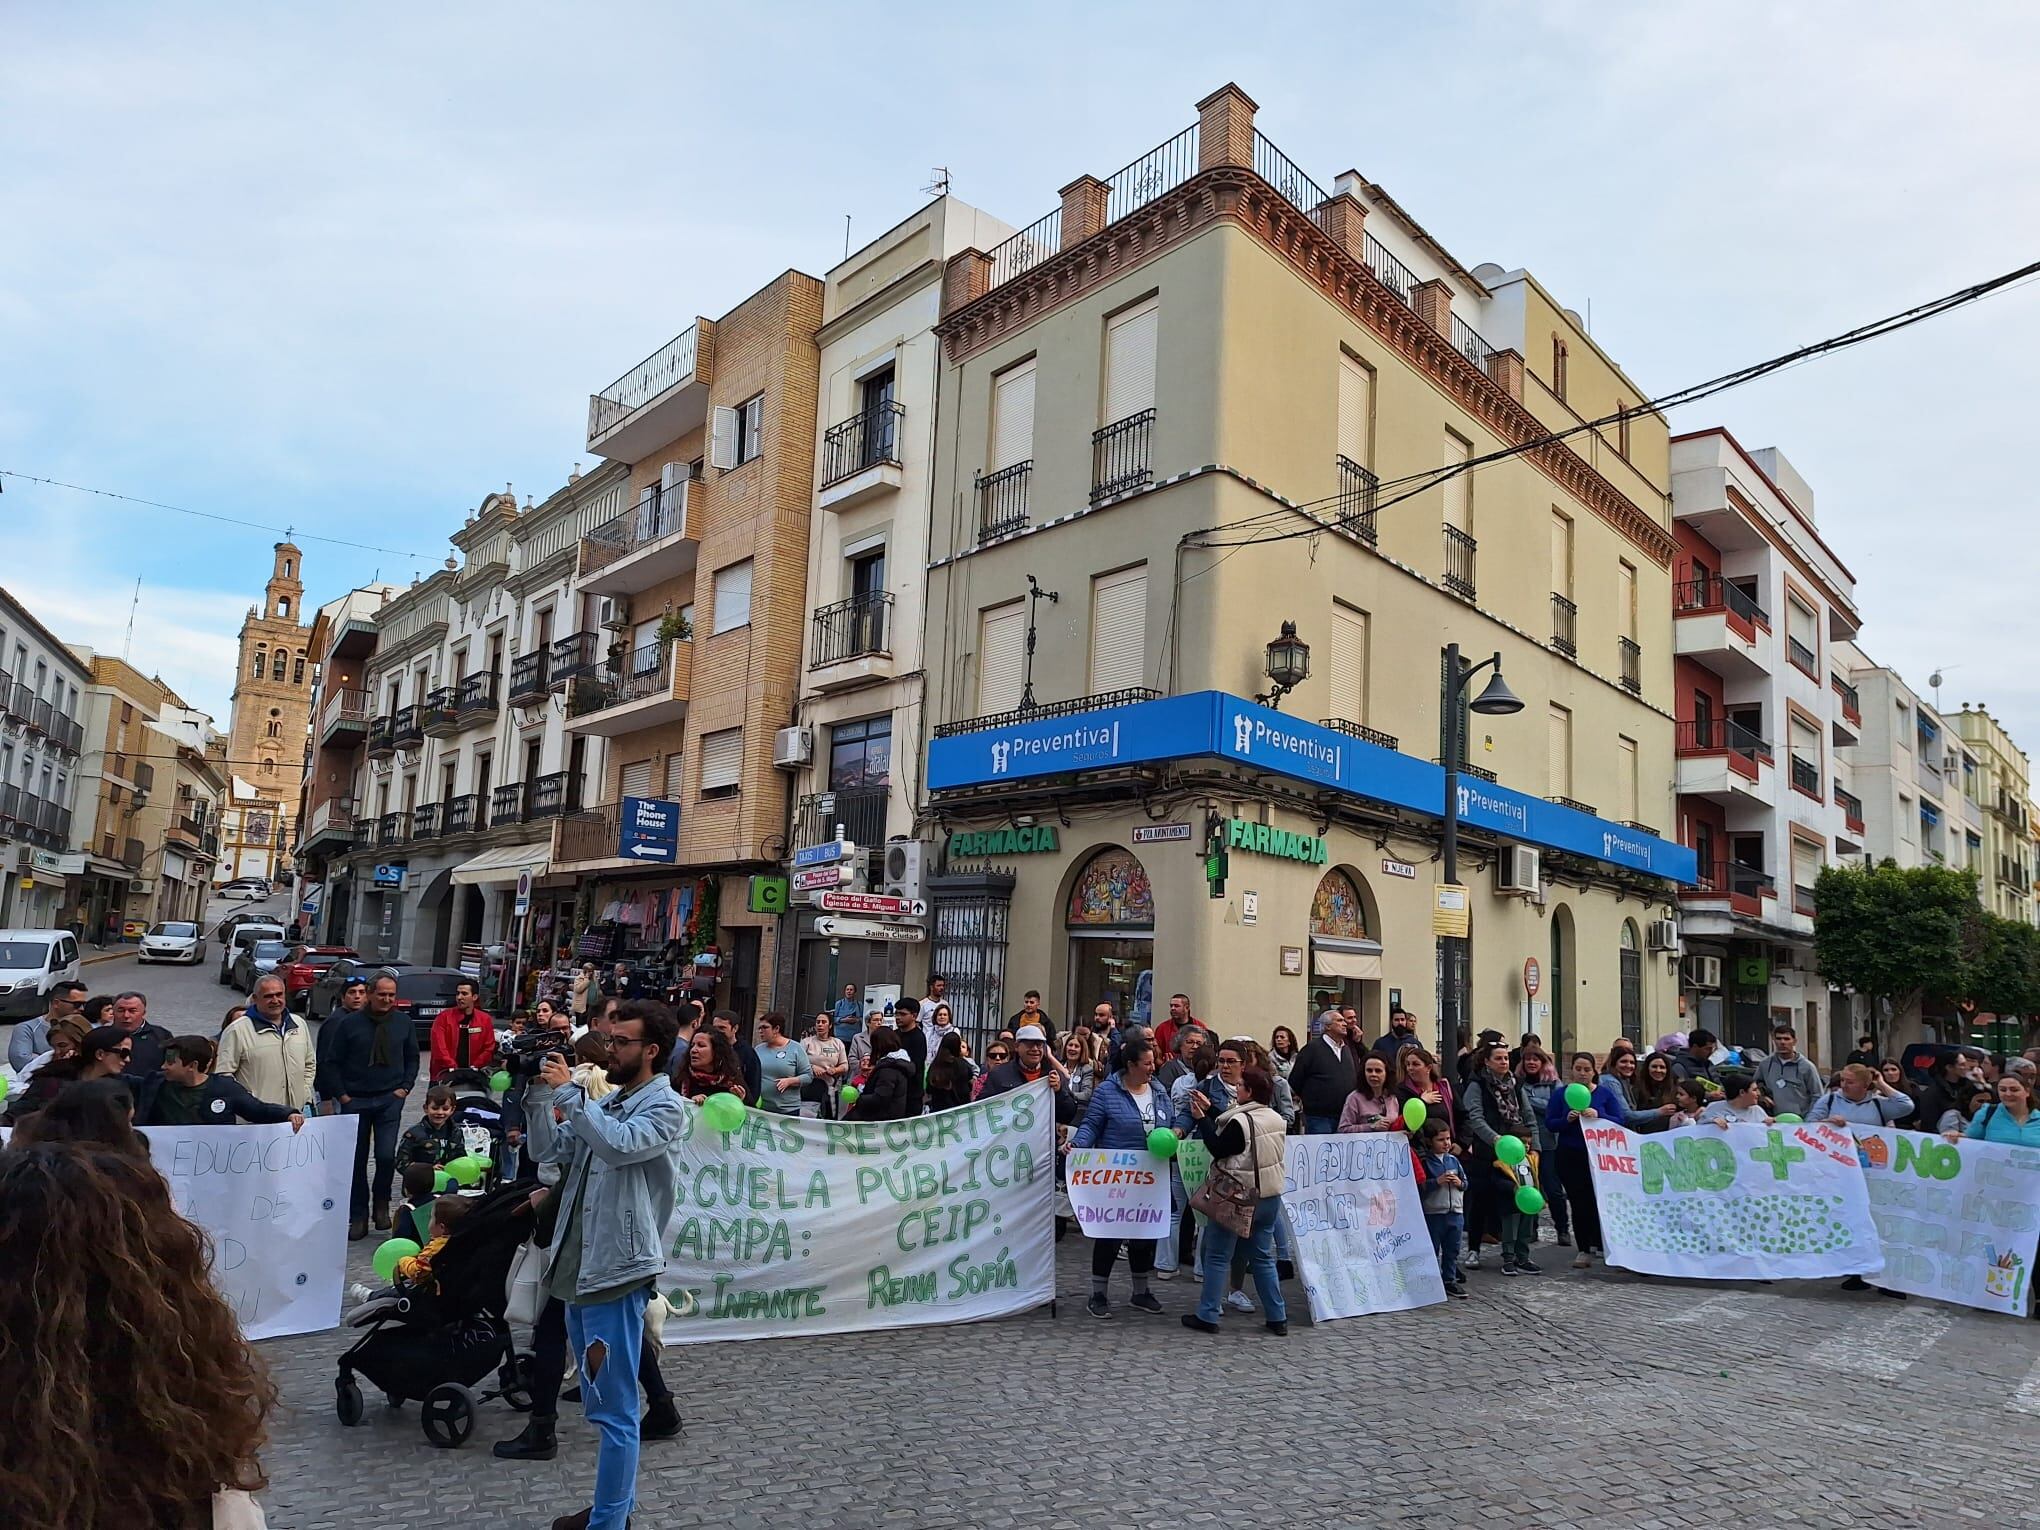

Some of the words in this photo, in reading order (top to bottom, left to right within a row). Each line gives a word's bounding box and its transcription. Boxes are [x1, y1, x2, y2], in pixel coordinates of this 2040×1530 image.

[1013, 726, 1110, 757] Preventiva
[1256, 721, 1334, 765] Preventiva
[637, 800, 656, 811] The
[1471, 789, 1522, 820] Preventiva
[636, 809, 667, 820] Phone
[636, 817, 666, 828] House
[950, 826, 1056, 857] FARMACIA
[1154, 826, 1189, 839] AYUNTAMIENTO
[1230, 819, 1328, 864] FARMACIA
[824, 846, 836, 858] BUS
[1612, 834, 1648, 858] Preventiva
[799, 851, 813, 861] TAXIS
[1391, 863, 1412, 875] NUEVA
[762, 885, 778, 904] C
[826, 893, 849, 901] Paseo
[863, 896, 882, 904] Gallo
[826, 900, 850, 908] Iglesia
[872, 903, 896, 911] Miguel
[865, 930, 890, 938] Salida
[892, 932, 919, 940] Ciudad
[882, 924, 919, 934] Juzgados
[825, 1093, 1035, 1155] RECORTES
[1585, 1128, 1628, 1151] AMPA
[1071, 1151, 1092, 1167] NO
[1096, 1152, 1108, 1165] A
[1185, 1156, 1203, 1167] DEL
[1640, 1136, 1738, 1195] NO
[1893, 1134, 1962, 1180] NO
[855, 1142, 1034, 1205] PÚBLICA
[1071, 1168, 1156, 1186] RECORTES
[1107, 1187, 1127, 1200] EN
[250, 1190, 288, 1221] DE
[1368, 1189, 1396, 1227] NO
